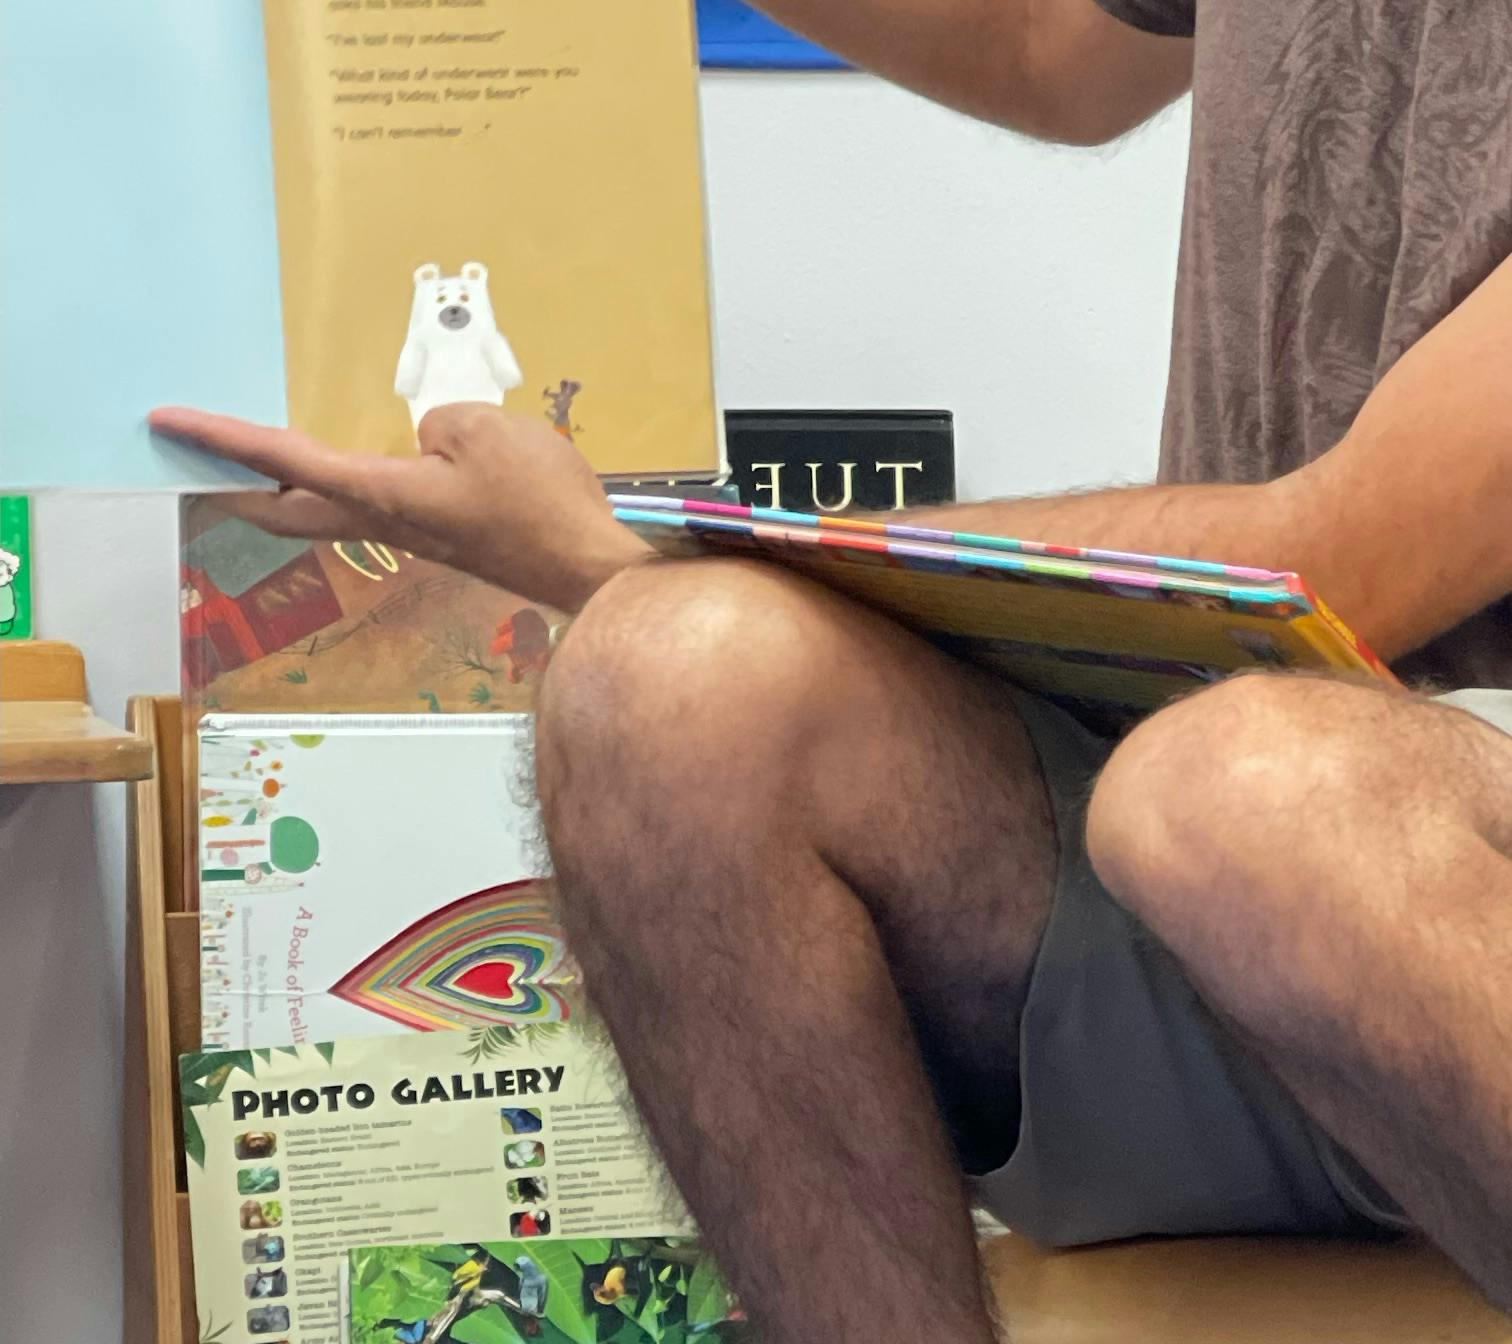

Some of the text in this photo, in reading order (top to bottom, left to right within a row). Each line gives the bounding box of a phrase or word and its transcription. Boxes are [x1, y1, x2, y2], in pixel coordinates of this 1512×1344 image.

[296, 906, 313, 920] A
[287, 925, 309, 970] Book
[286, 975, 304, 992] of
[232, 1066, 564, 1121] PHOTO GALLERY
